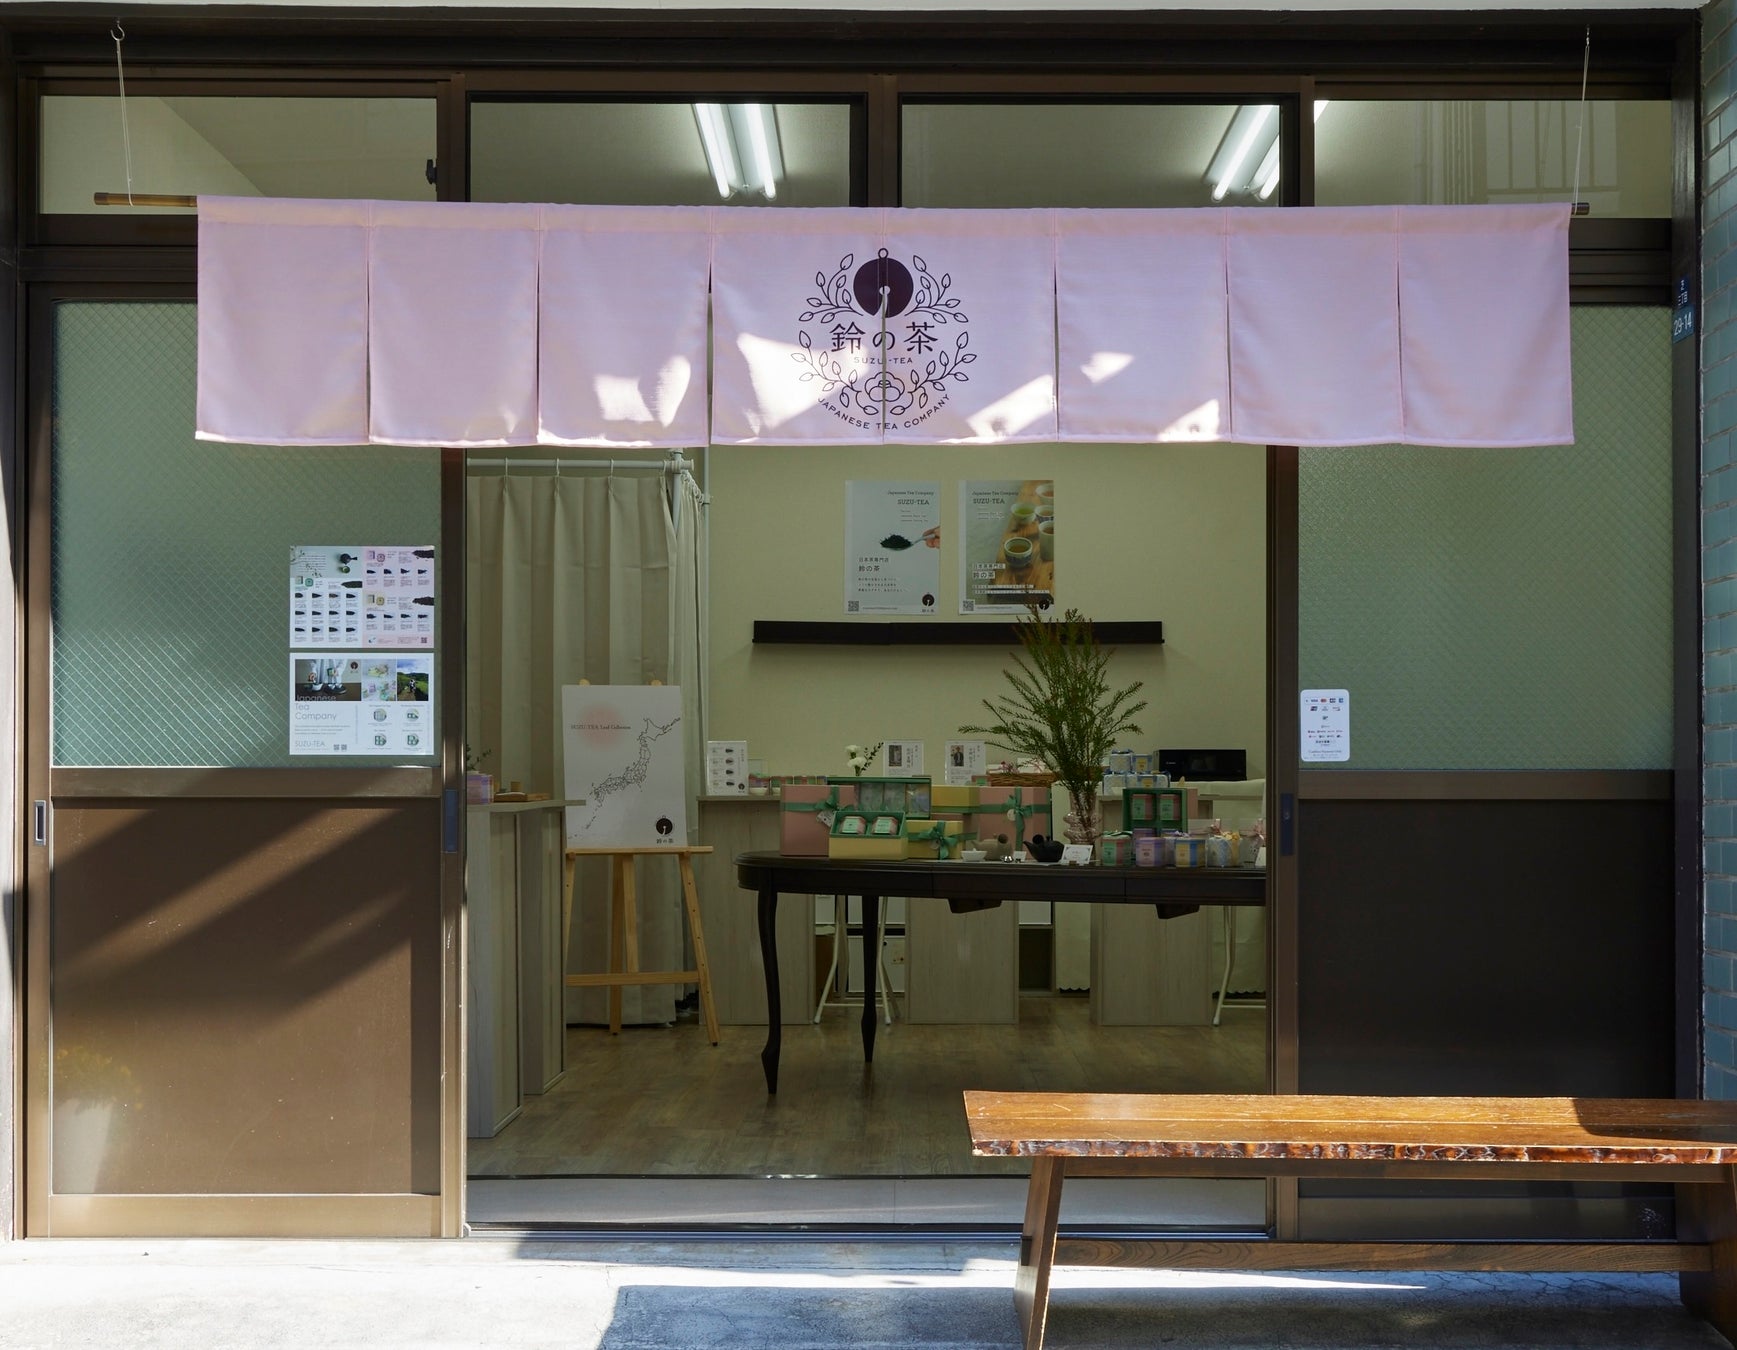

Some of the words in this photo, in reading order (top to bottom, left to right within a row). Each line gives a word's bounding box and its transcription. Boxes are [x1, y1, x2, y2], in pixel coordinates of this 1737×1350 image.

[1673, 311, 1692, 336] 29-14
[829, 321, 939, 355] 鈴の茶
[817, 396, 870, 430] JAPANESE
[875, 422, 898, 430] TEA
[903, 393, 951, 430] COMPANY
[295, 703, 310, 711] Tea
[295, 712, 337, 721] Company
